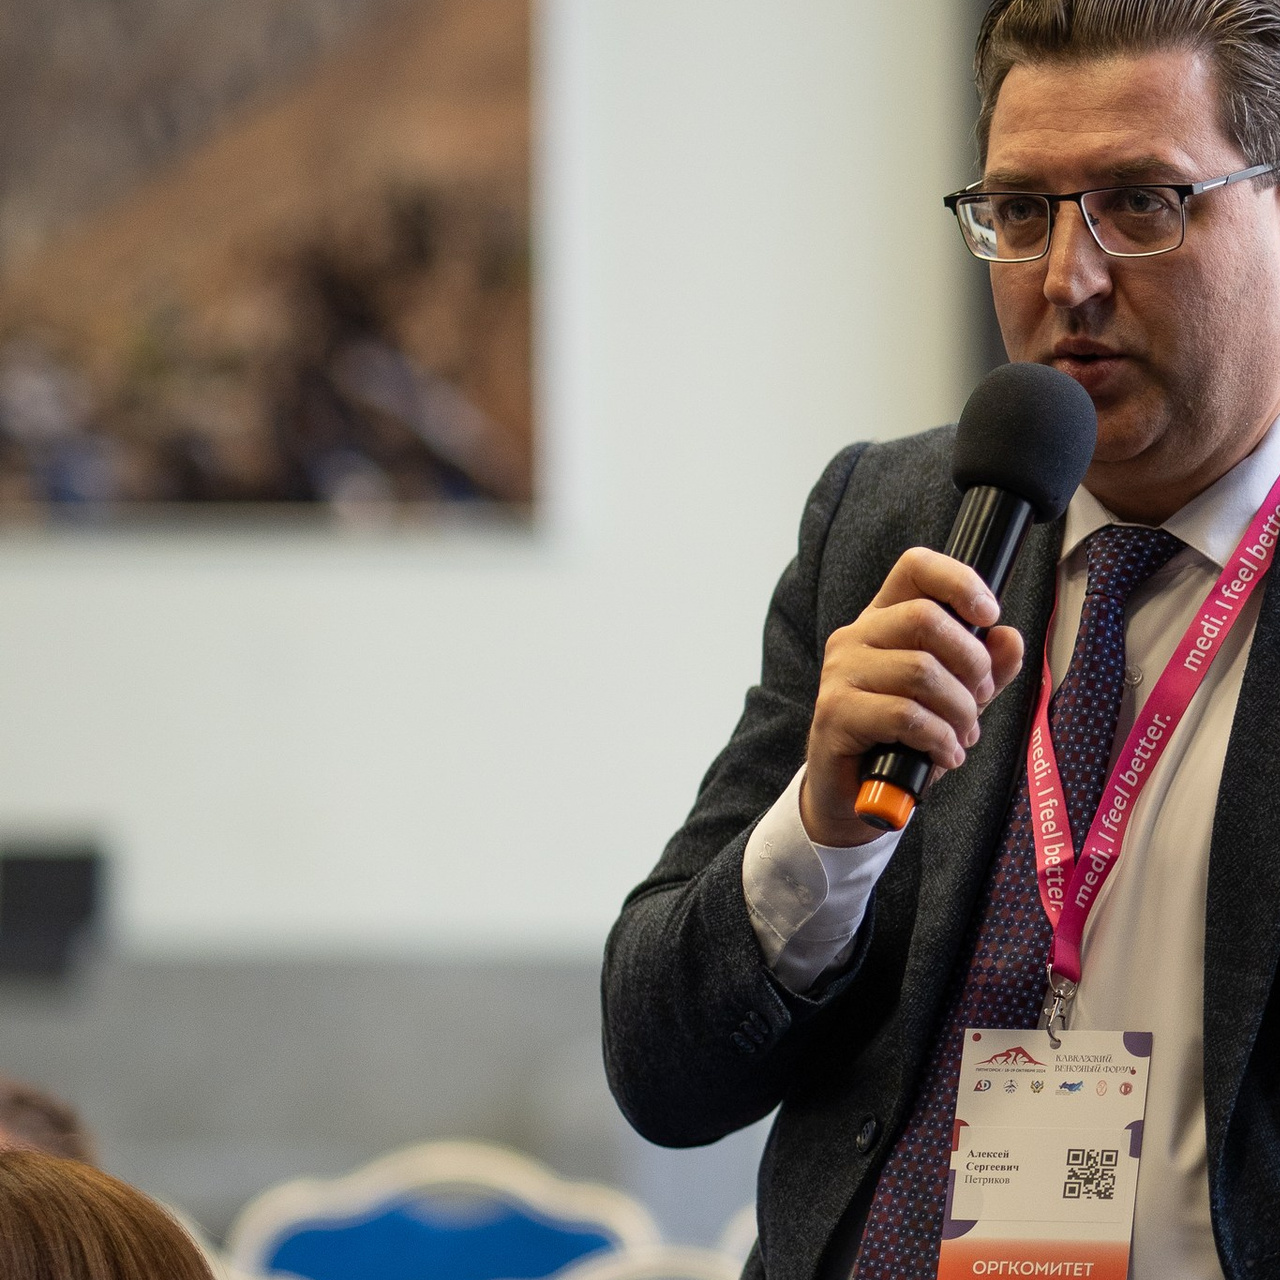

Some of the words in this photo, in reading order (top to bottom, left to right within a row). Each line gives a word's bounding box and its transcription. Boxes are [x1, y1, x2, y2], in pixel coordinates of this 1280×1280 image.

[1184, 614, 1228, 672] medi.
[1221, 557, 1259, 600] feel
[1032, 726, 1052, 787] medi.
[1039, 798, 1064, 841] feel
[1075, 846, 1114, 909] medi.
[1102, 785, 1131, 831] feel
[1119, 713, 1172, 789] better.
[1043, 843, 1066, 913] better.
[965, 1161, 1020, 1174] Сергеевич
[967, 1149, 1010, 1159] Алексей
[964, 1174, 1011, 1186] Петриков
[972, 1260, 1095, 1277] ОРГКОМИТЕТ
